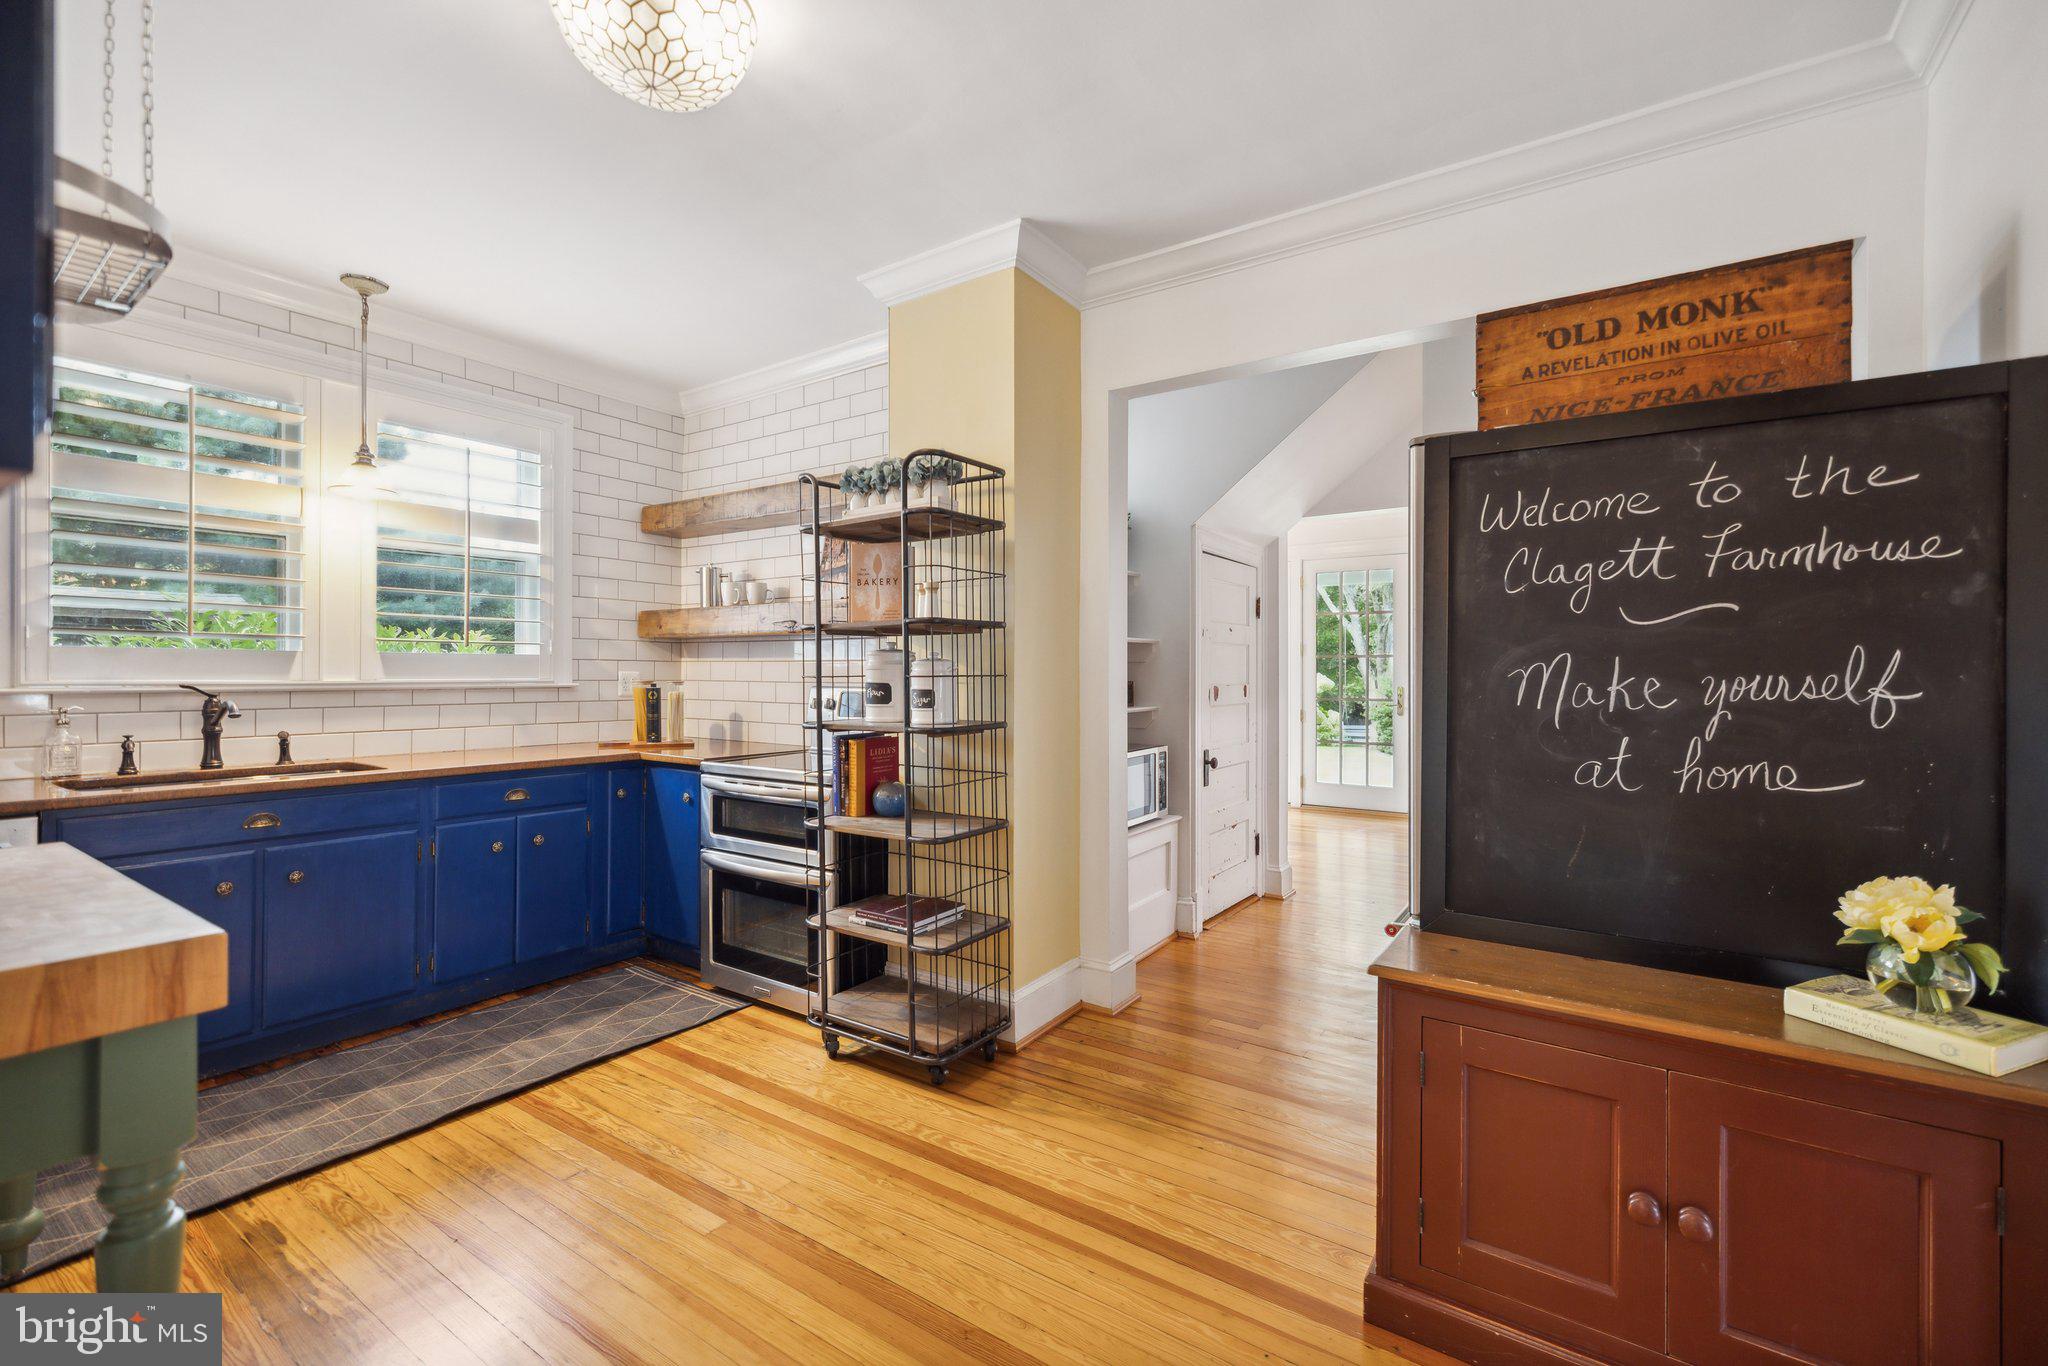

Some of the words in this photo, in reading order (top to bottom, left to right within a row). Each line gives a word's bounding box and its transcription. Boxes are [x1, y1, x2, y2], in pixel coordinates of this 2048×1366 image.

[1521, 366, 1535, 381] A
[1538, 344, 1654, 378] REVELATION
[1660, 339, 1681, 356] IN
[1688, 327, 1748, 350] OLIVE
[1756, 320, 1791, 340] OIL
[1615, 366, 1687, 386] FROM
[1480, 486, 1660, 533] Welcome
[1689, 460, 1742, 508] to
[1785, 454, 1920, 499] the
[856, 577, 899, 587] BAKERY
[1504, 535, 1677, 614] Clagett
[1702, 522, 1963, 578] Farmhouse
[1507, 652, 1678, 730] Make
[1699, 644, 1923, 742] yourself
[1574, 736, 1644, 792] at
[1673, 736, 1865, 794] home
